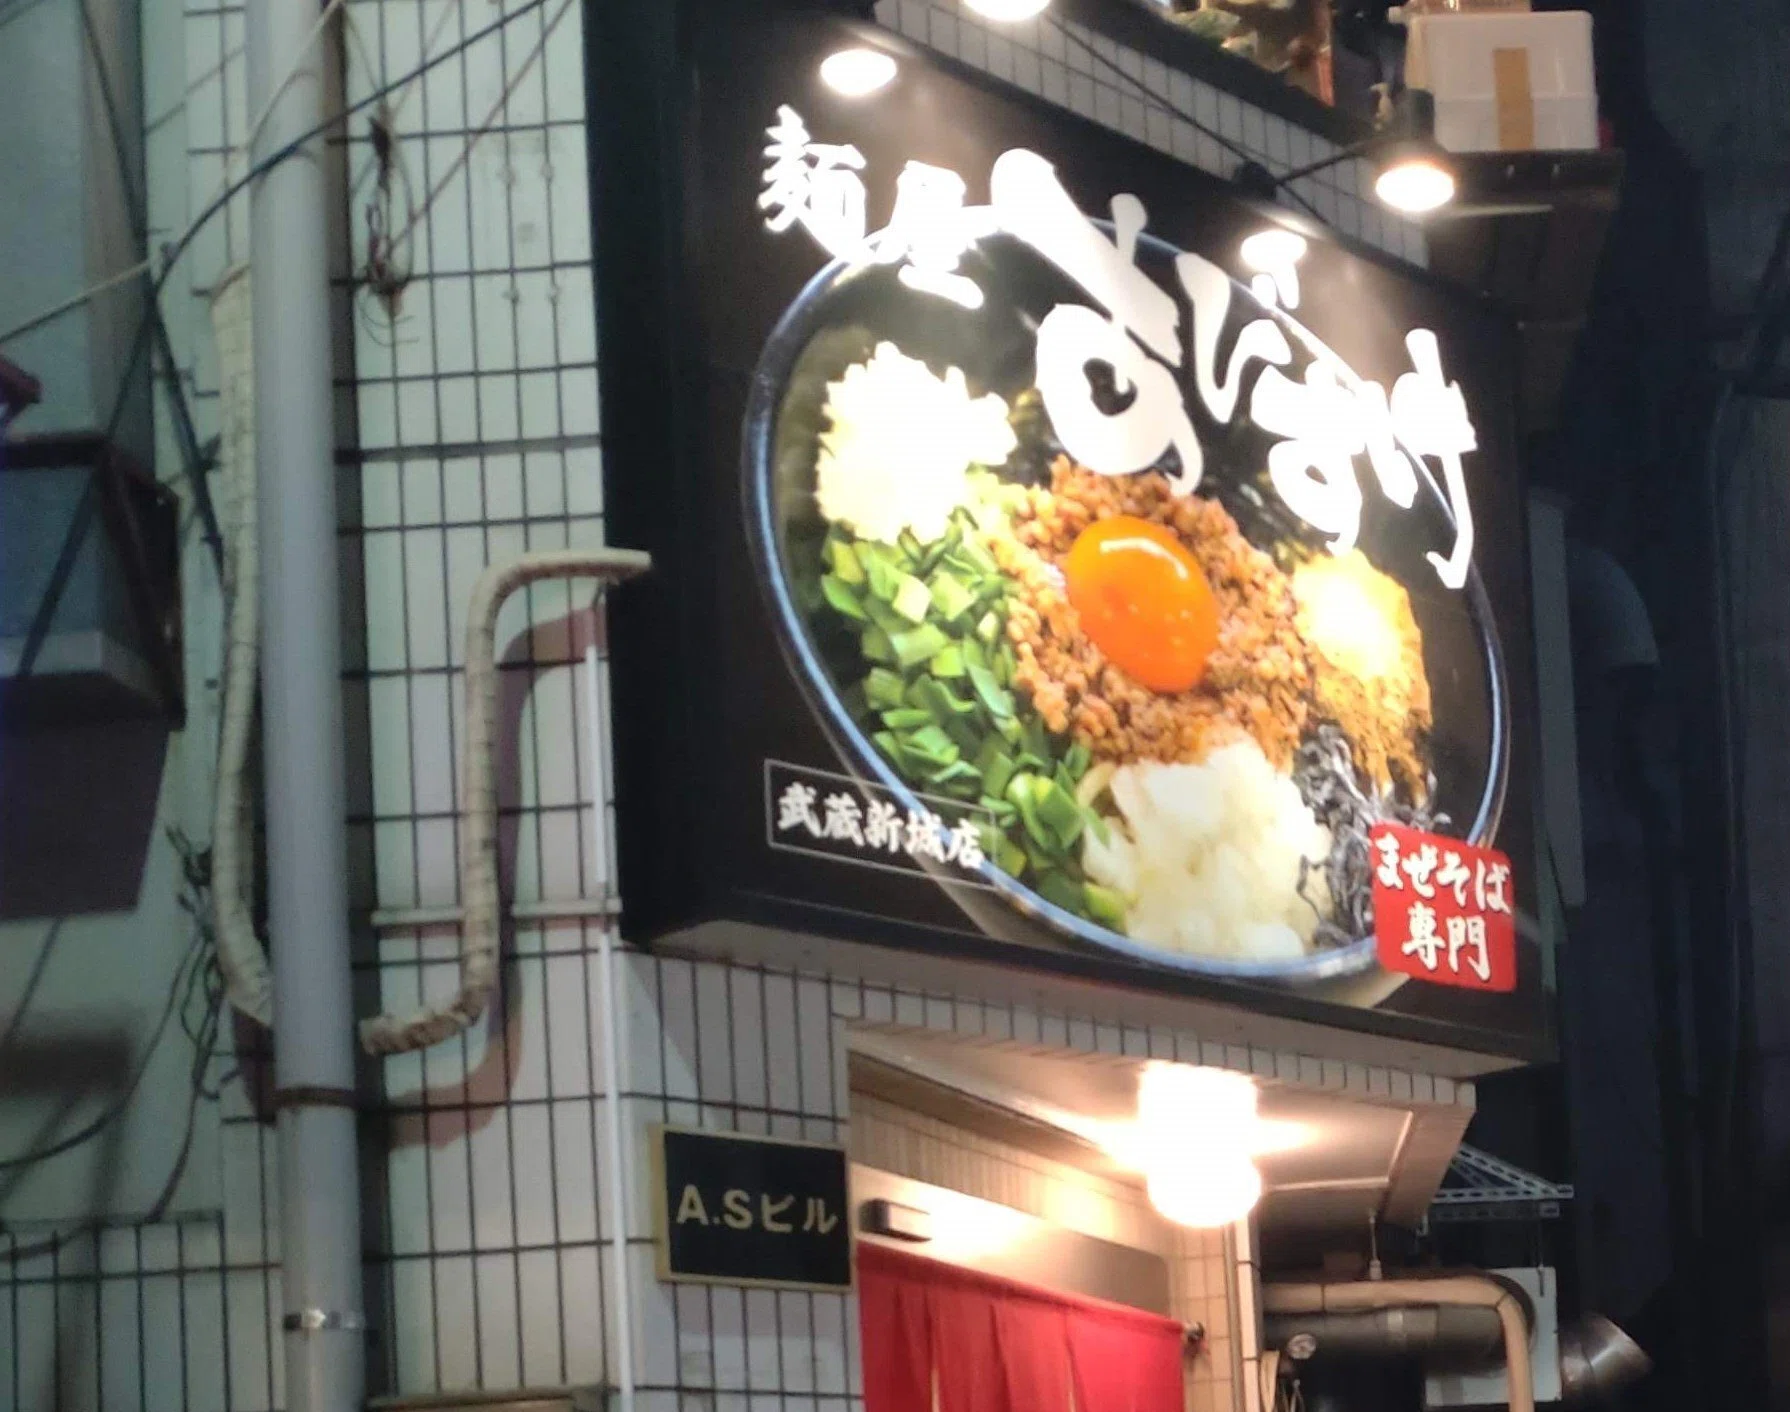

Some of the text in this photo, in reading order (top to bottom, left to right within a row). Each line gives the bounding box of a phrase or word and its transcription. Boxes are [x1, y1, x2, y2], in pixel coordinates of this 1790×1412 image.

[777, 781, 986, 870] 武蔵新城店
[1375, 831, 1512, 916] まぜそば
[1401, 900, 1492, 981] 専門
[675, 1183, 840, 1235] A.Sビル
